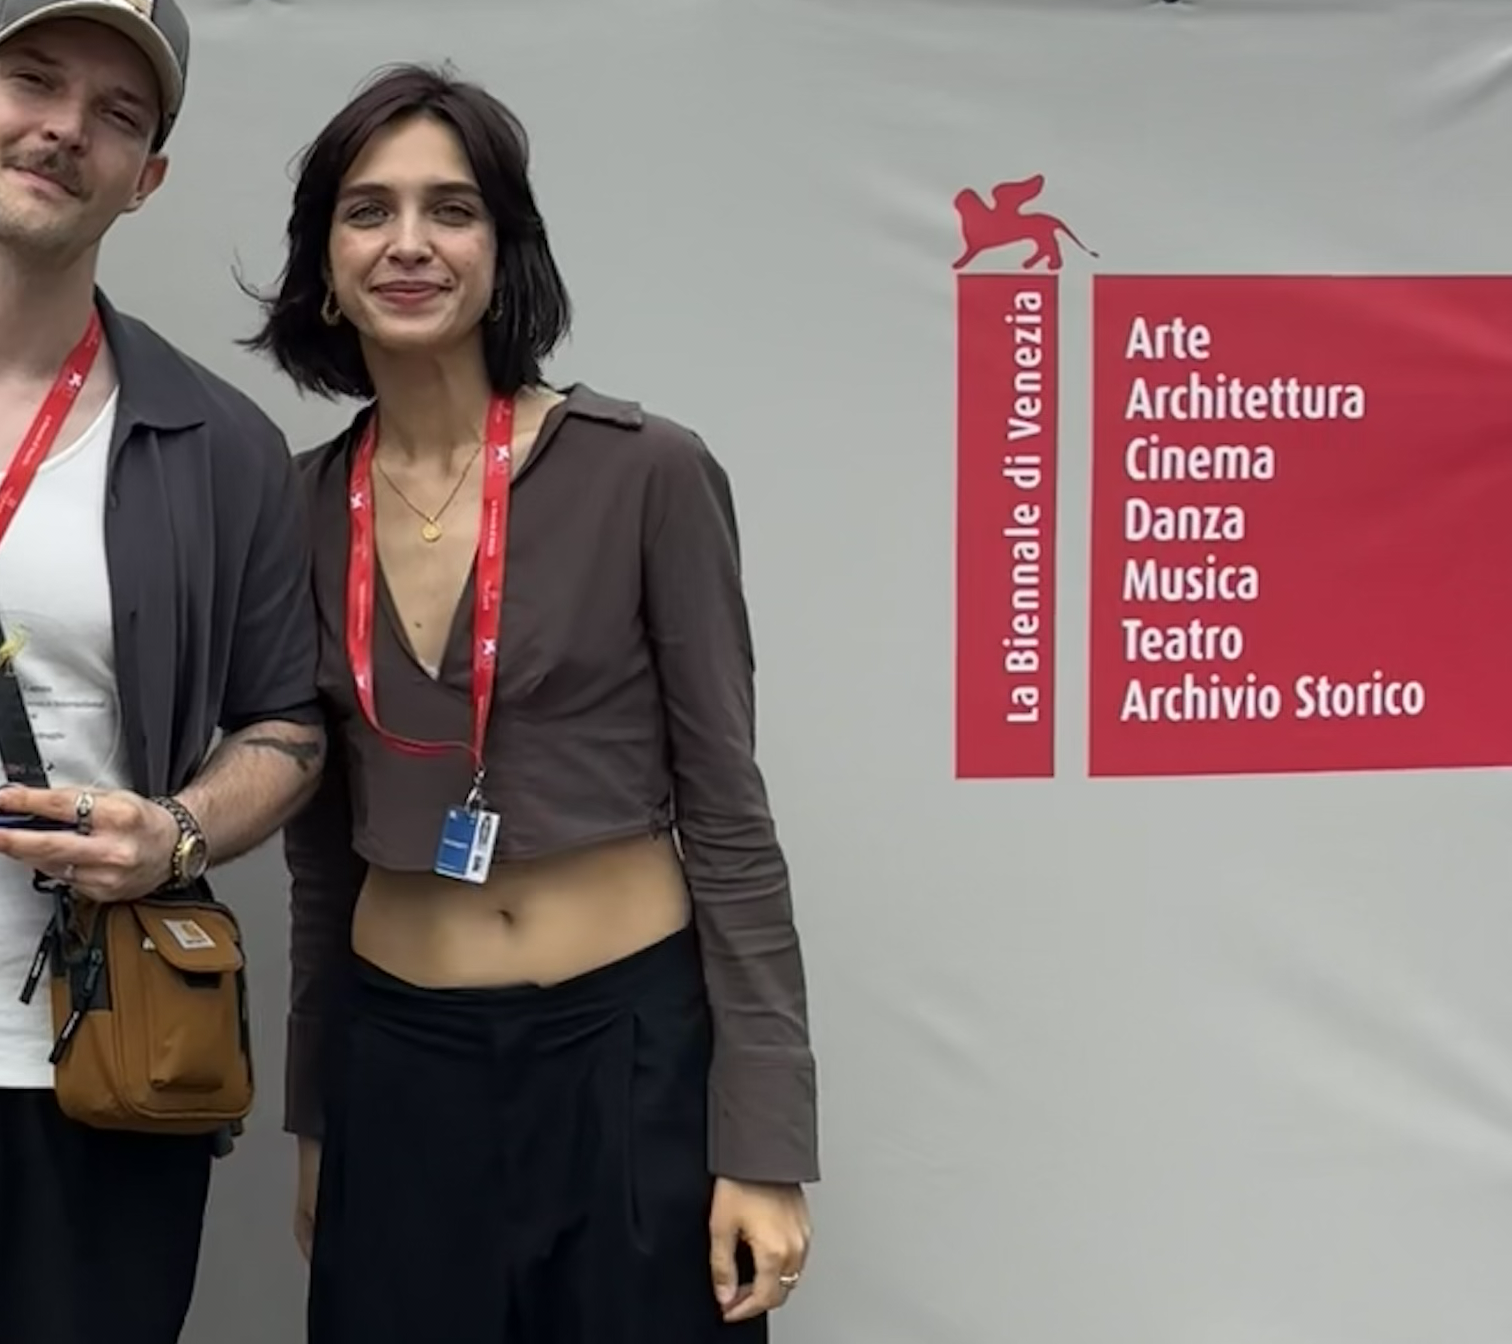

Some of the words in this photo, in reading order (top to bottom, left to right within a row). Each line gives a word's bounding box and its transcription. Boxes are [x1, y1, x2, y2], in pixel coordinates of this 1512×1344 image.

[1126, 317, 1211, 359] Arte
[1005, 290, 1042, 440] Venezia
[1125, 372, 1365, 420] Architettura
[1003, 454, 1041, 489] di
[1126, 434, 1275, 481] Cinema
[1125, 498, 1245, 541] Danza
[1002, 502, 1040, 672] Biennale
[1123, 554, 1259, 601] Musica
[1122, 619, 1243, 661] Teatro
[1006, 686, 1039, 722] La
[1121, 673, 1281, 721] Archivio
[1295, 670, 1425, 718] Storico
